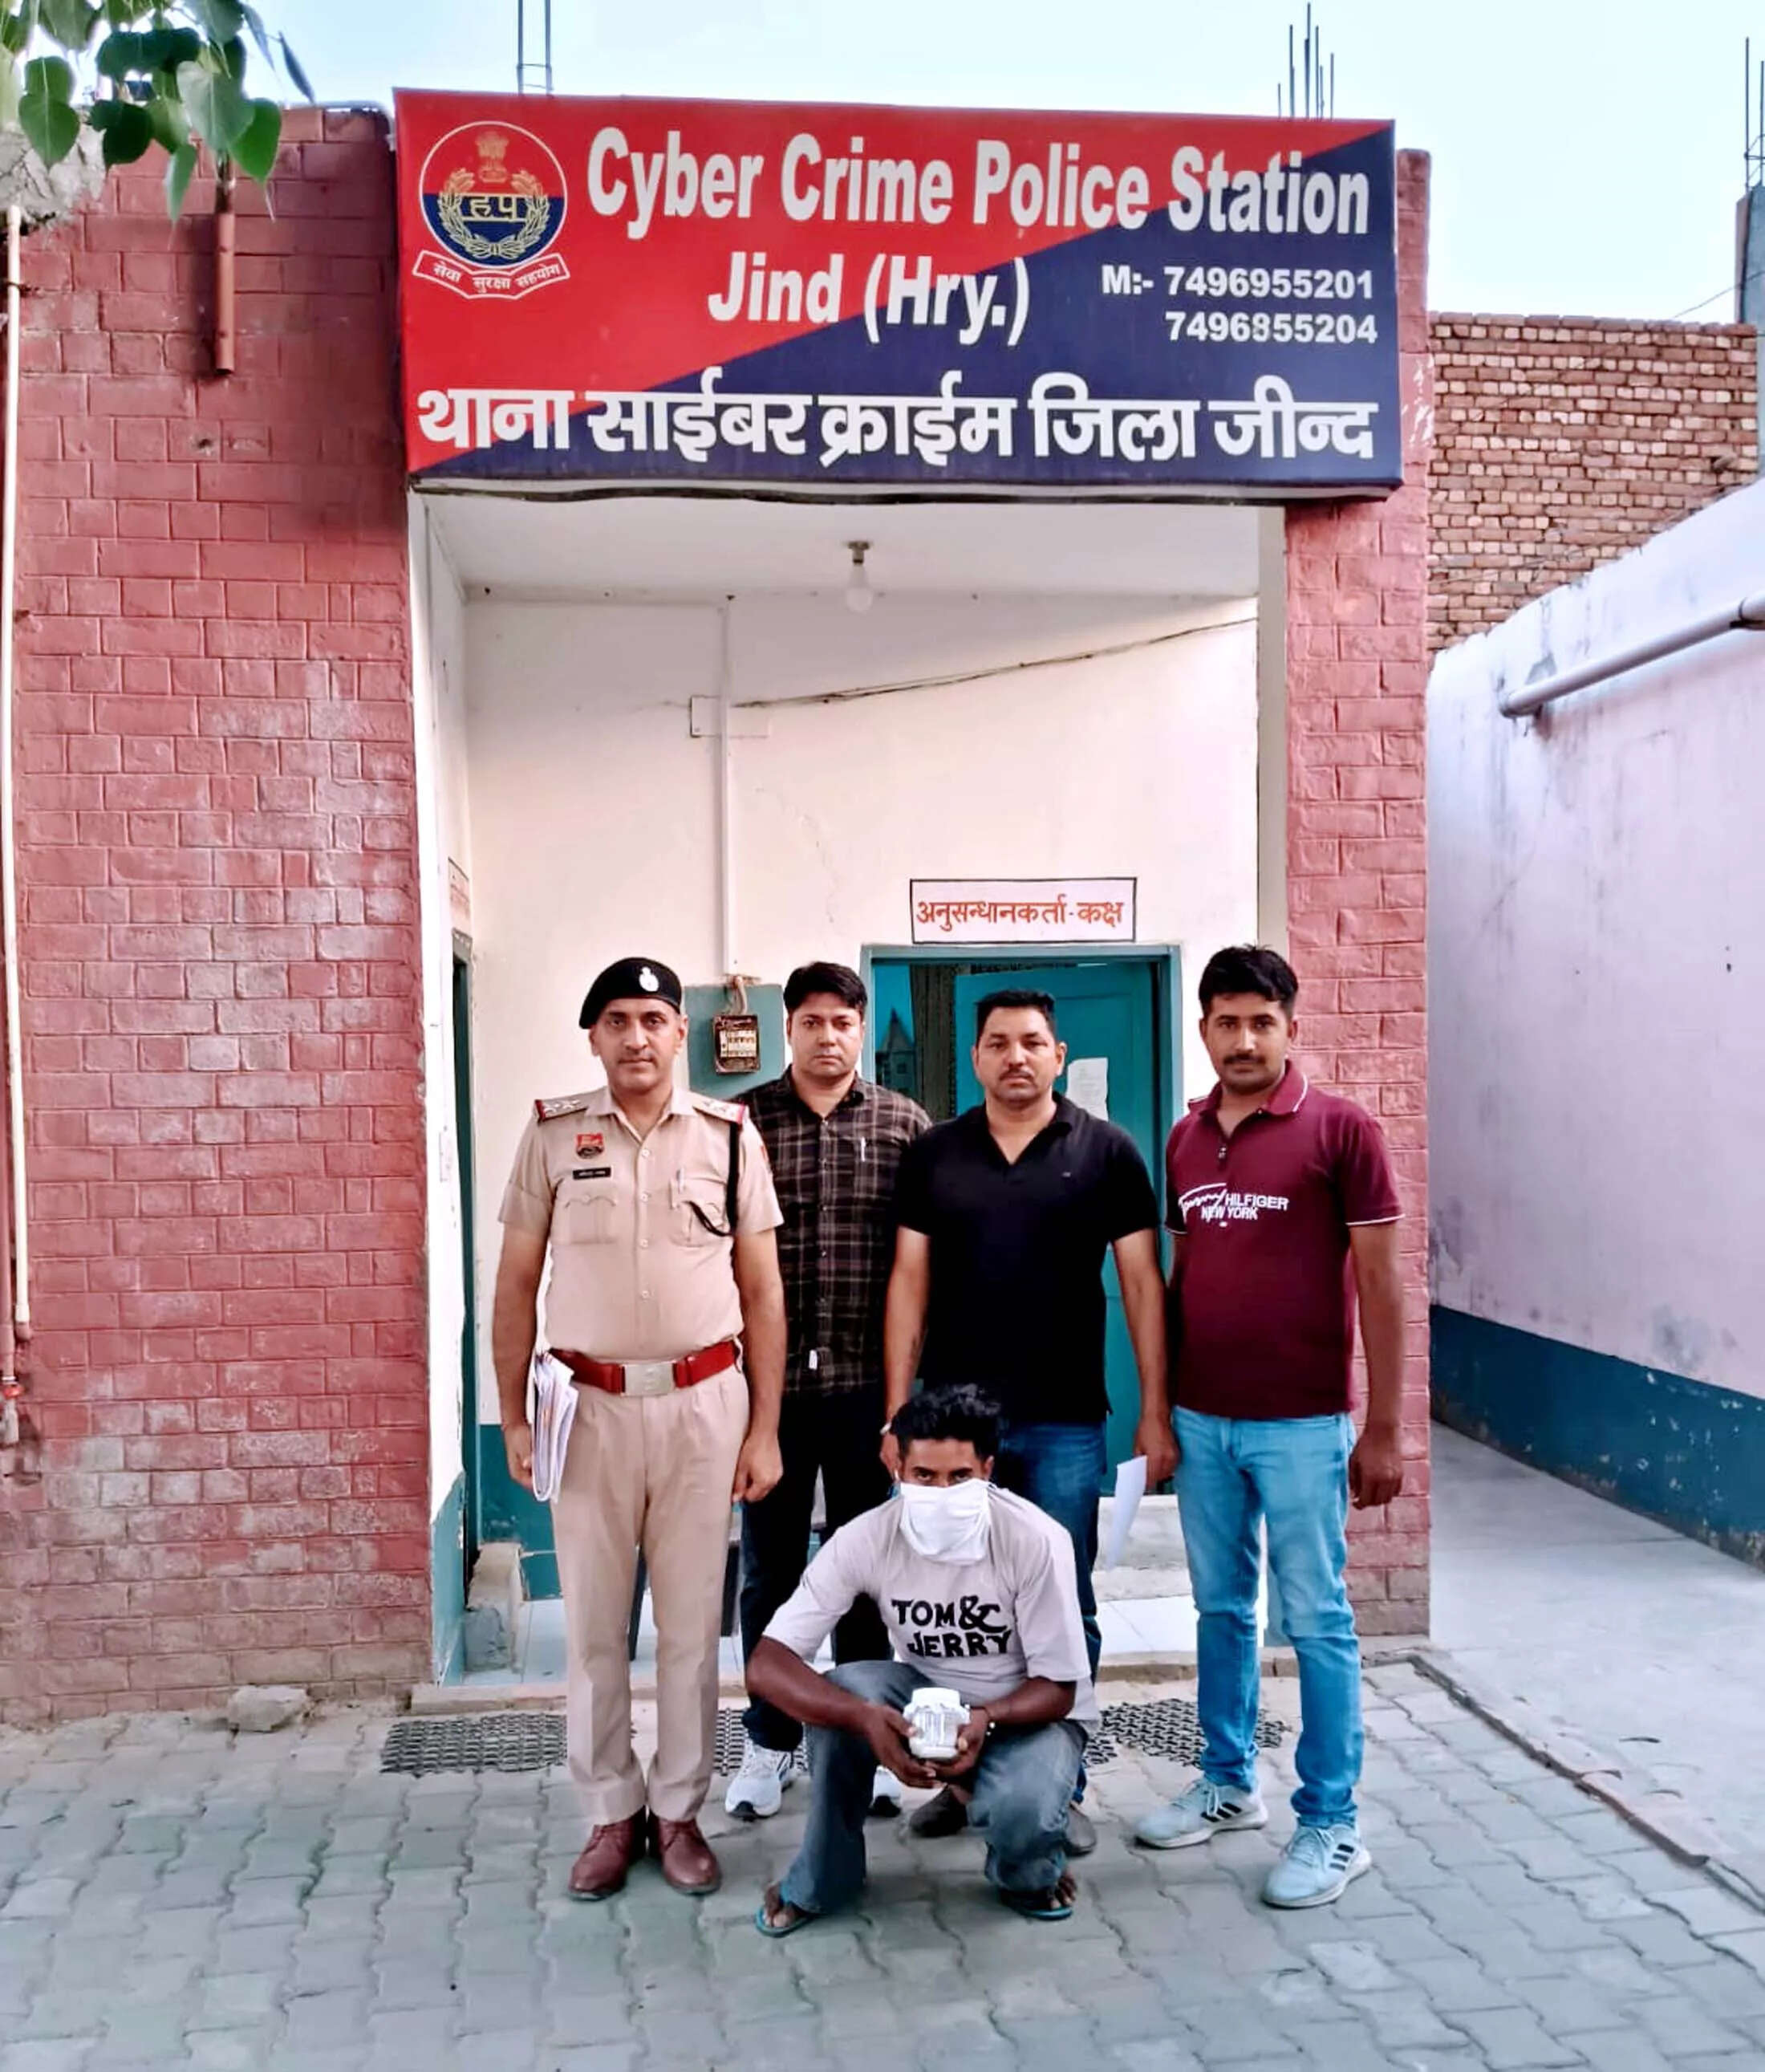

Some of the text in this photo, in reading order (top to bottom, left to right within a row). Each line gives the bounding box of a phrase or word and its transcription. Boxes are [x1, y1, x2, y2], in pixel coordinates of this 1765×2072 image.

[586, 127, 1369, 239] Cyber Crime Police Station
[1102, 264, 1373, 299] M:- 7496955201
[708, 252, 1030, 345] Jind (Hry.)
[1166, 311, 1378, 343] 7496855204
[416, 366, 1379, 468] थाना साईबर क्राईम जिला जीन्द
[1201, 1205, 1259, 1221] NEW YORK
[1225, 1192, 1289, 1211] HILFIGER
[907, 1630, 1012, 1658] JERRY
